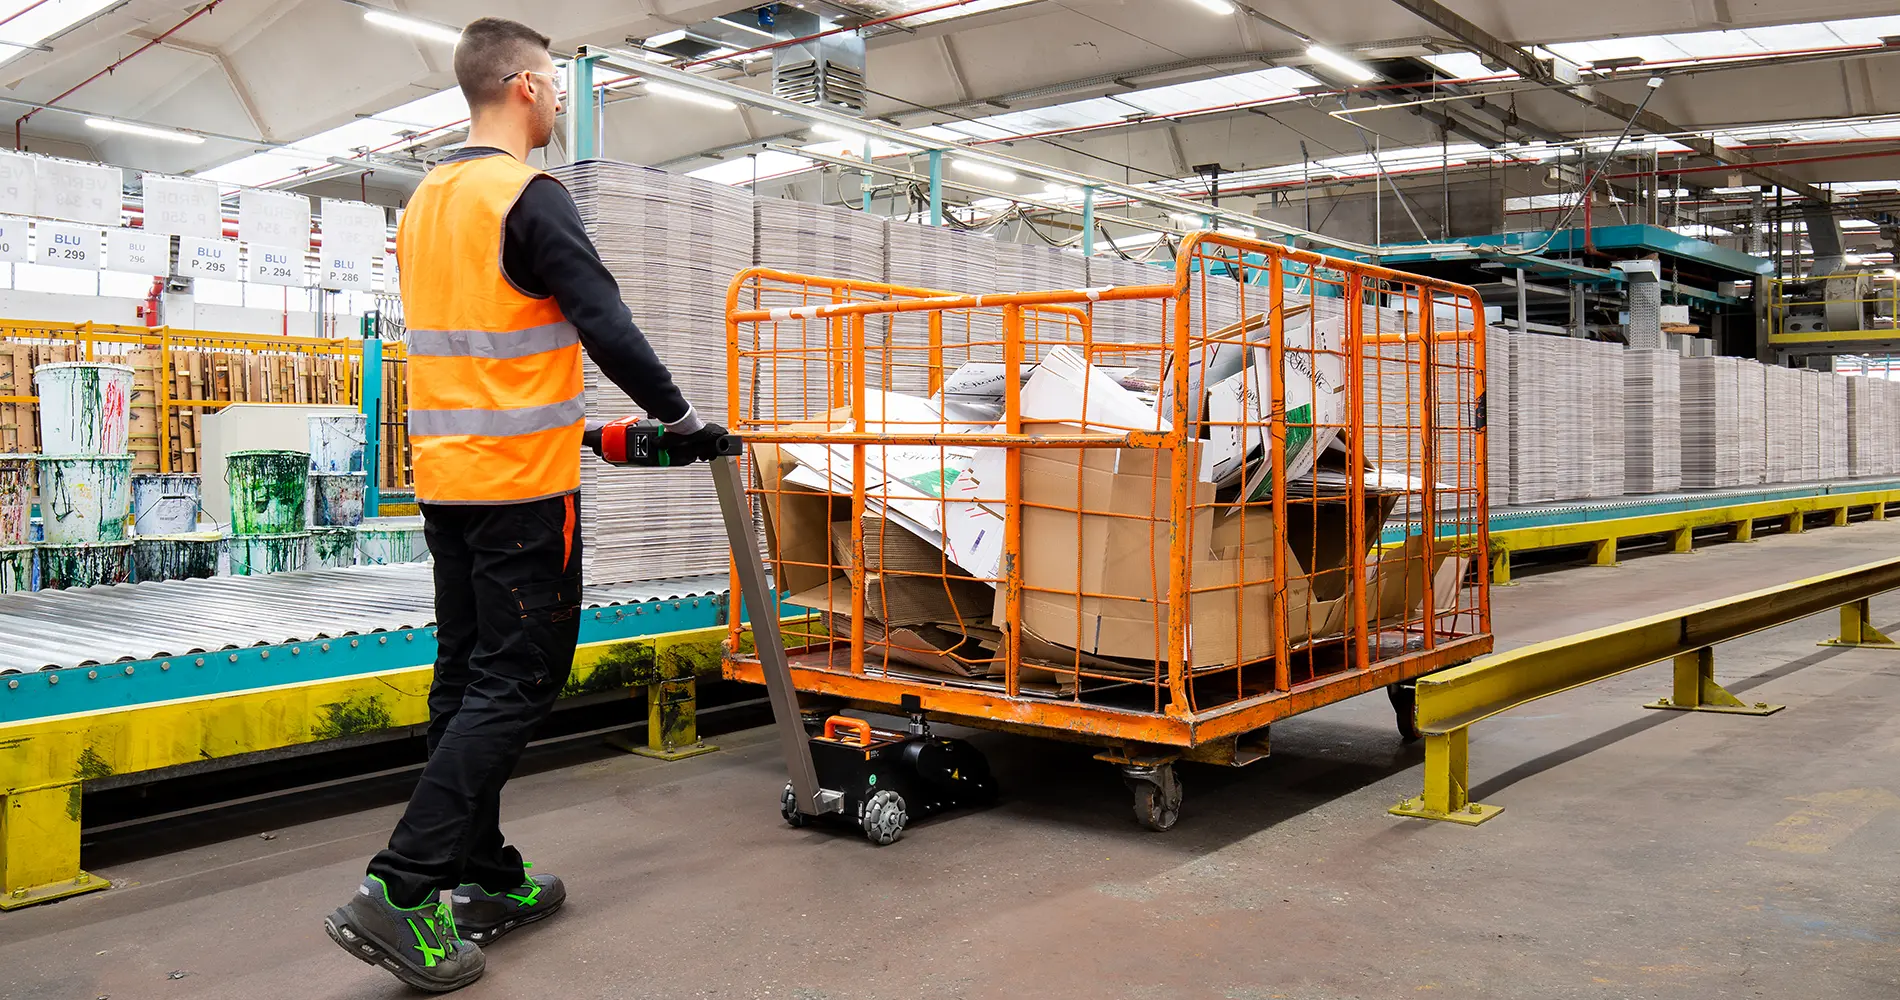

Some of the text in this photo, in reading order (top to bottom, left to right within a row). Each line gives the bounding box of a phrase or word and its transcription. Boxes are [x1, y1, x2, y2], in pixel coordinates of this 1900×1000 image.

[54, 233, 81, 246] BLU
[129, 243, 146, 251] BLU
[197, 247, 221, 259] BLU
[48, 247, 86, 261] P. 299
[129, 255, 145, 264] 296
[264, 253, 287, 264] BLU
[191, 259, 226, 273] P. 295
[333, 259, 355, 270] BLU
[259, 266, 291, 278] P. 294
[329, 271, 359, 283] P. 286
